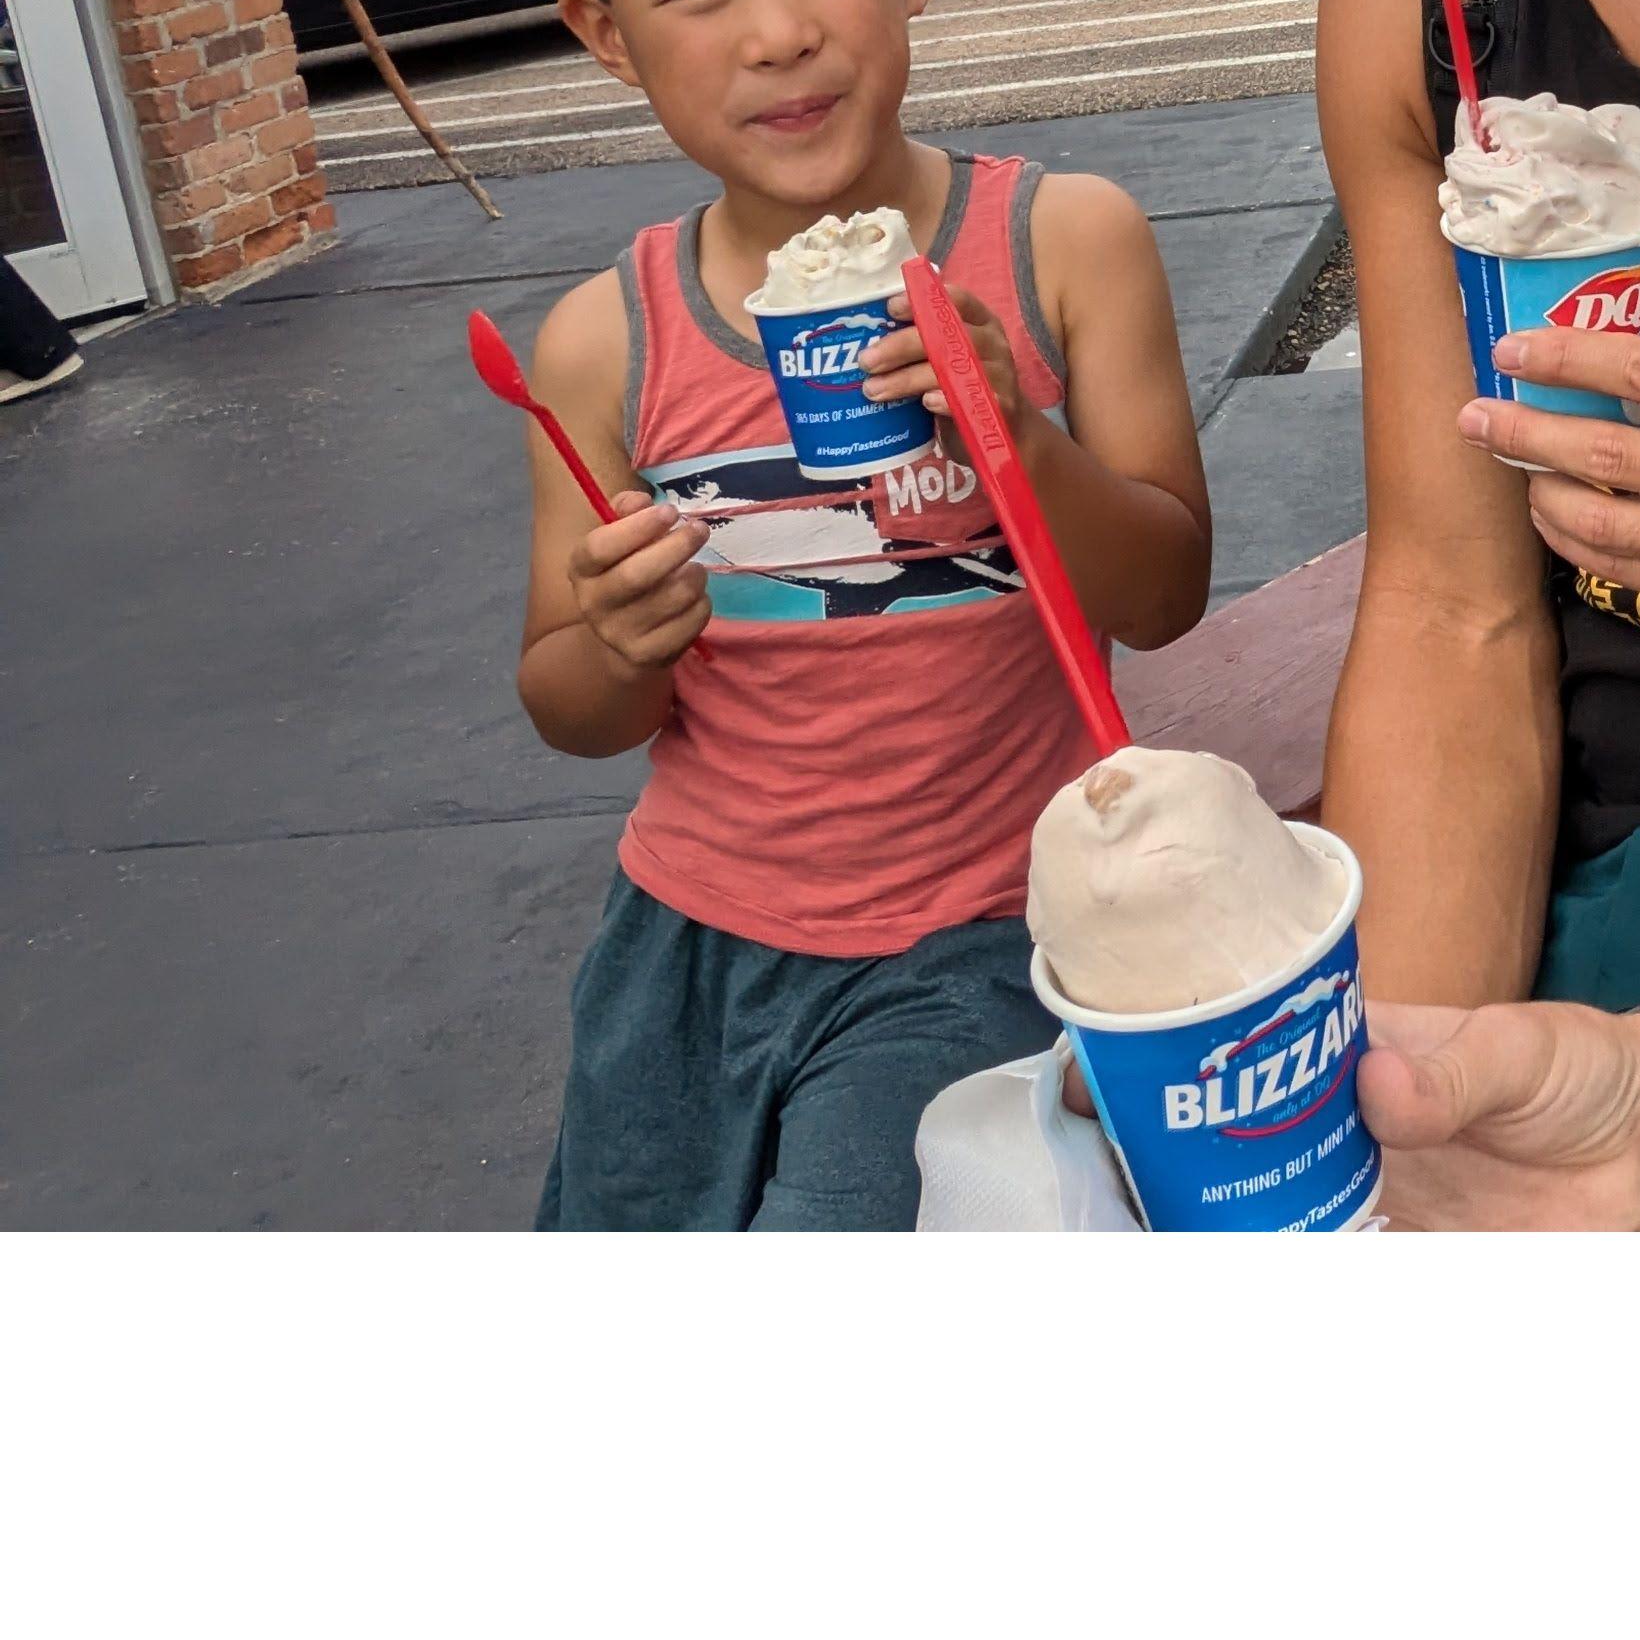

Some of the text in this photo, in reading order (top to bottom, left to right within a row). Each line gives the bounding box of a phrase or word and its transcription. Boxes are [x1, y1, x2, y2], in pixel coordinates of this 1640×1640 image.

[809, 412, 830, 424] DAYS
[832, 410, 843, 422] OF
[846, 402, 885, 420] SUMMER
[816, 429, 909, 456] #HappyTastesGood
[1163, 960, 1365, 1130] BLIZZARD
[1257, 1006, 1321, 1058] The Original
[1273, 1101, 1298, 1123] only
[1202, 1168, 1281, 1204] ANYTHING
[1286, 1149, 1314, 1181] BUT
[1317, 1124, 1343, 1161] MINI
[1346, 1110, 1356, 1136] IN
